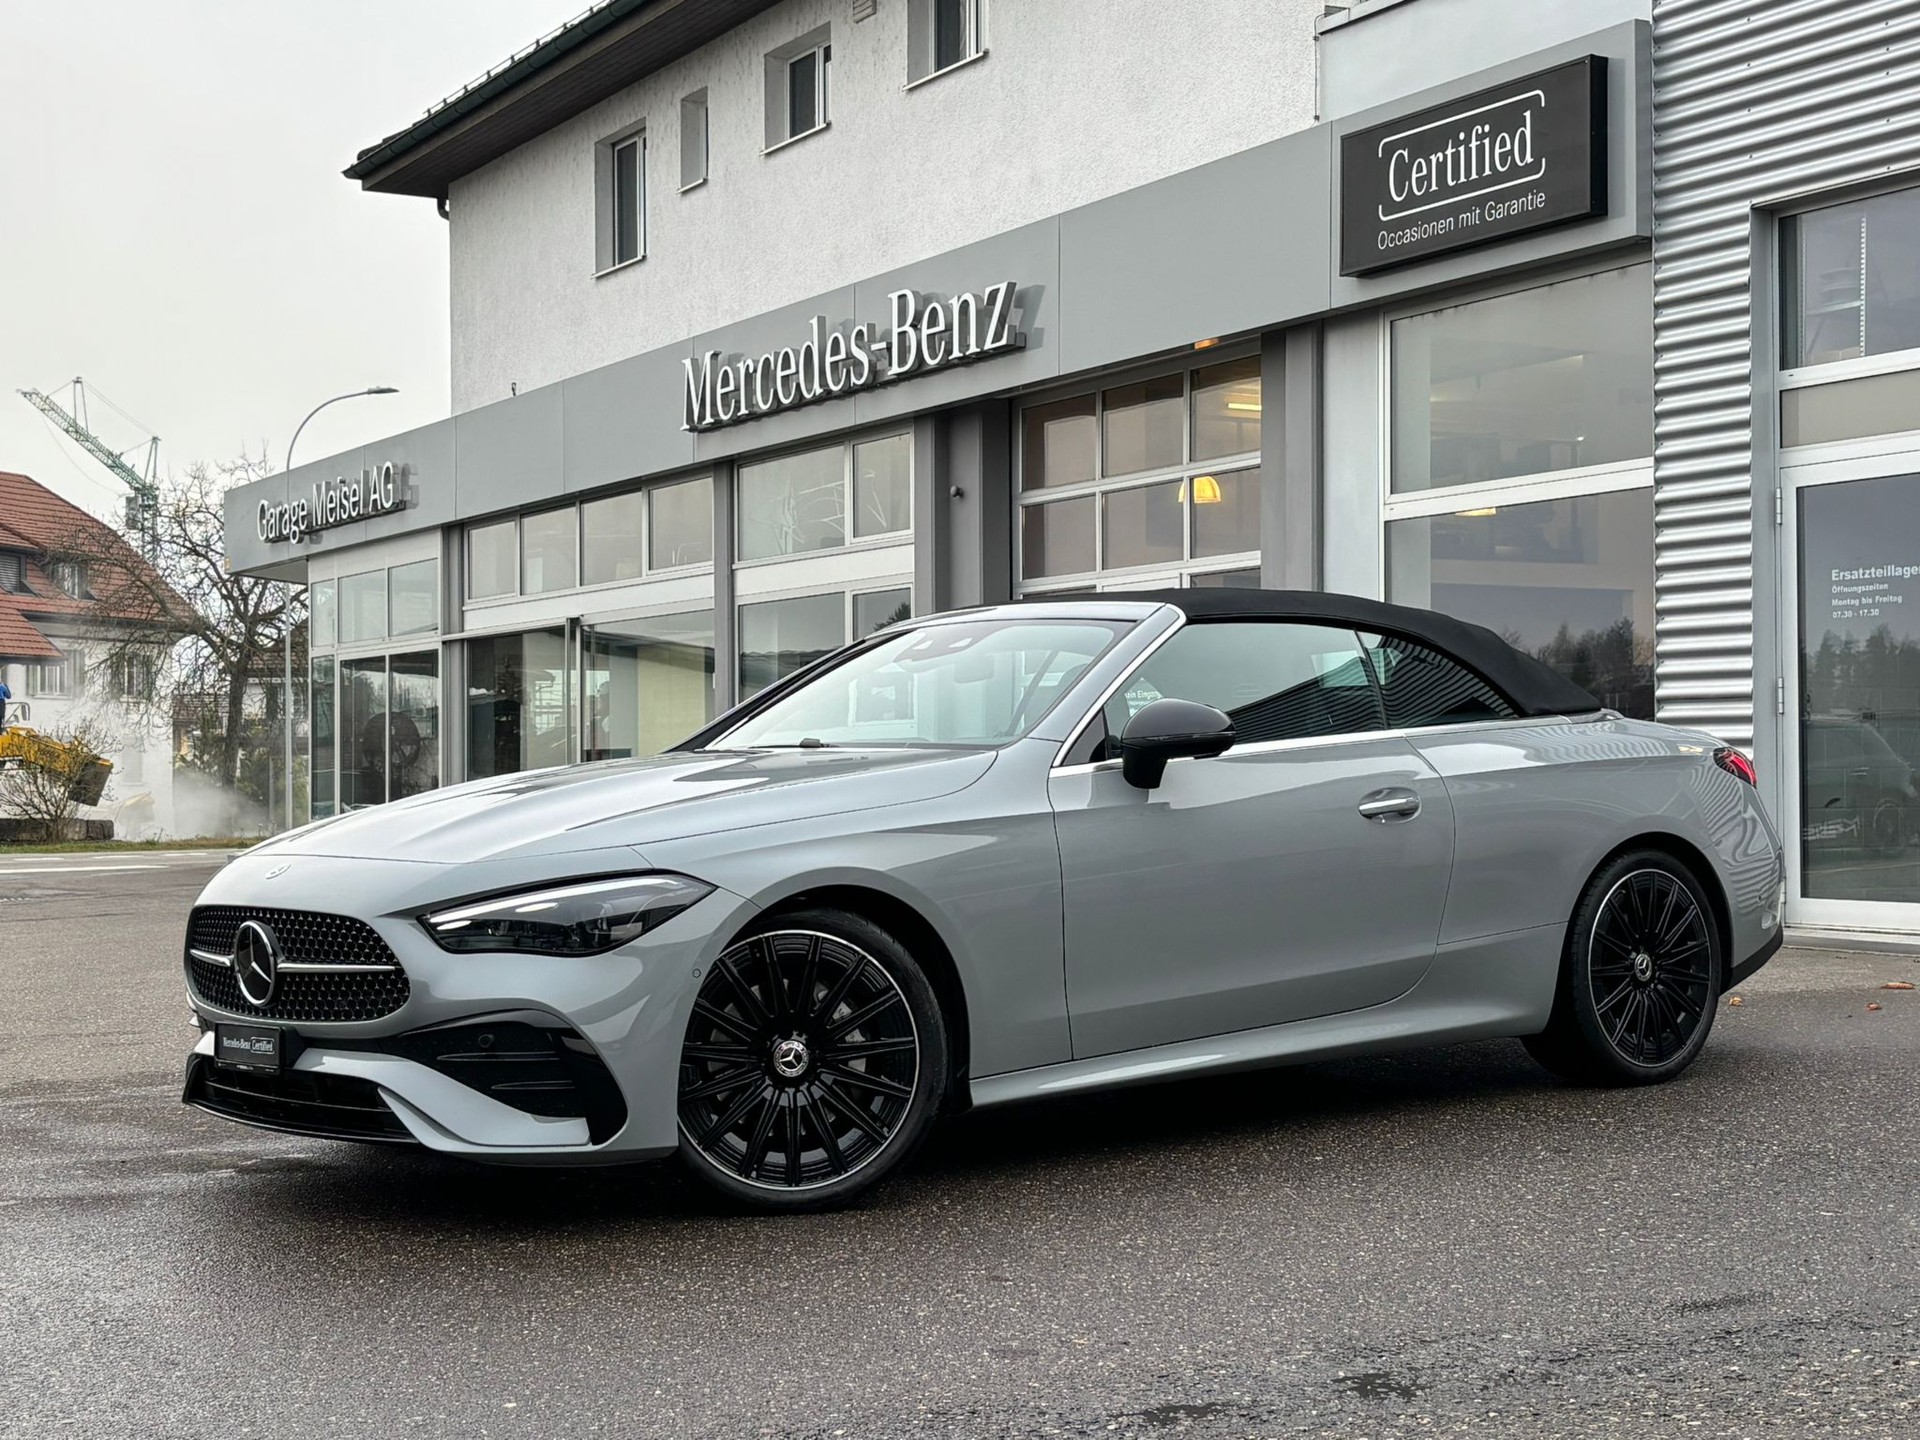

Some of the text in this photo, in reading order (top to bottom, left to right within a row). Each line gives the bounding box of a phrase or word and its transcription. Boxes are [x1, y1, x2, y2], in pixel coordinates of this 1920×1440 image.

[1388, 109, 1534, 202] Certified
[1378, 189, 1546, 250] Occasionen mit Garantie
[680, 281, 1018, 431] Mercedes-Benz
[257, 461, 394, 544] Garage Meisel AG
[1831, 583, 1889, 594] Öffnungszeiten
[1831, 594, 1903, 607] Montag bis Freitag
[1832, 611, 1853, 619] 07.30
[1859, 608, 1880, 617] 17.30
[252, 1039, 273, 1052] Certified
